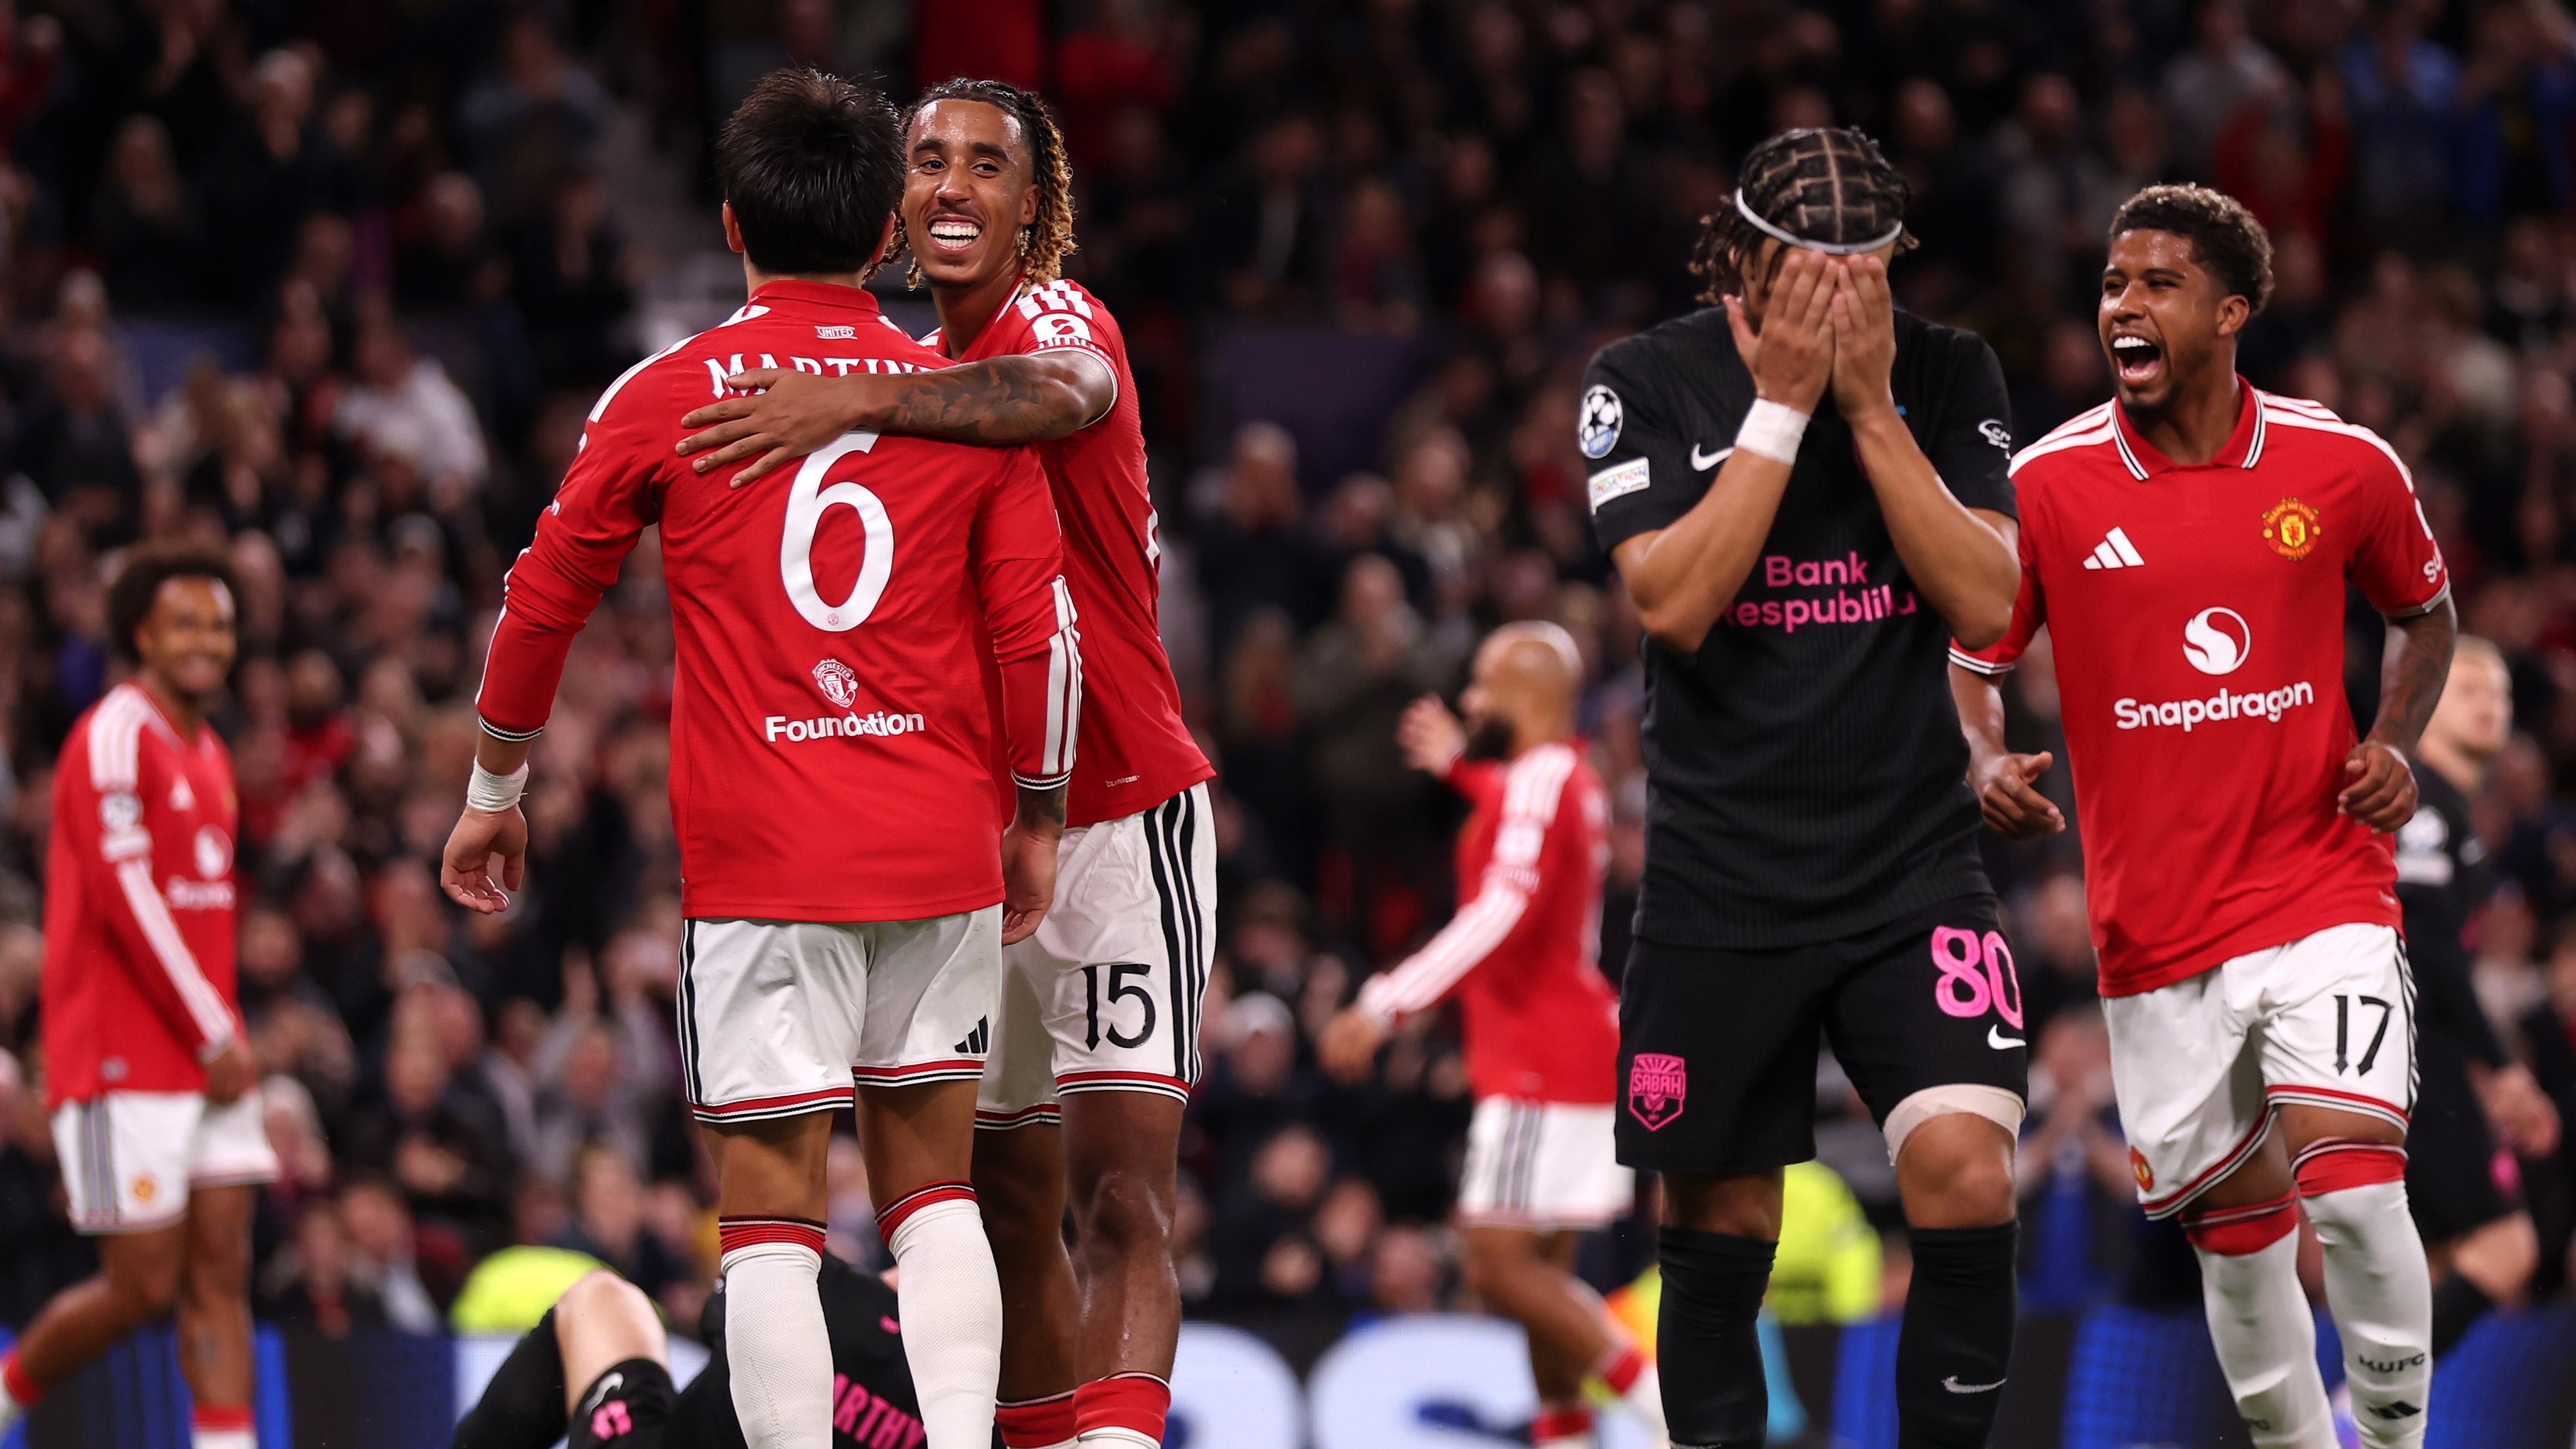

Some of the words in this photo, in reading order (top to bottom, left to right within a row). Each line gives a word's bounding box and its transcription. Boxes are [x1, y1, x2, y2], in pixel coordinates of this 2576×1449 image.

[816, 328, 854, 337] UNITED
[780, 429, 894, 632] 6
[1765, 550, 1868, 588] Bank
[765, 709, 925, 743] Foundation
[2113, 681, 2314, 732] Snapdragon
[1930, 924, 2024, 1030] 80
[1081, 964, 1157, 1053] 15
[2332, 993, 2395, 1077] 17
[1633, 1073, 1682, 1095] SABAH
